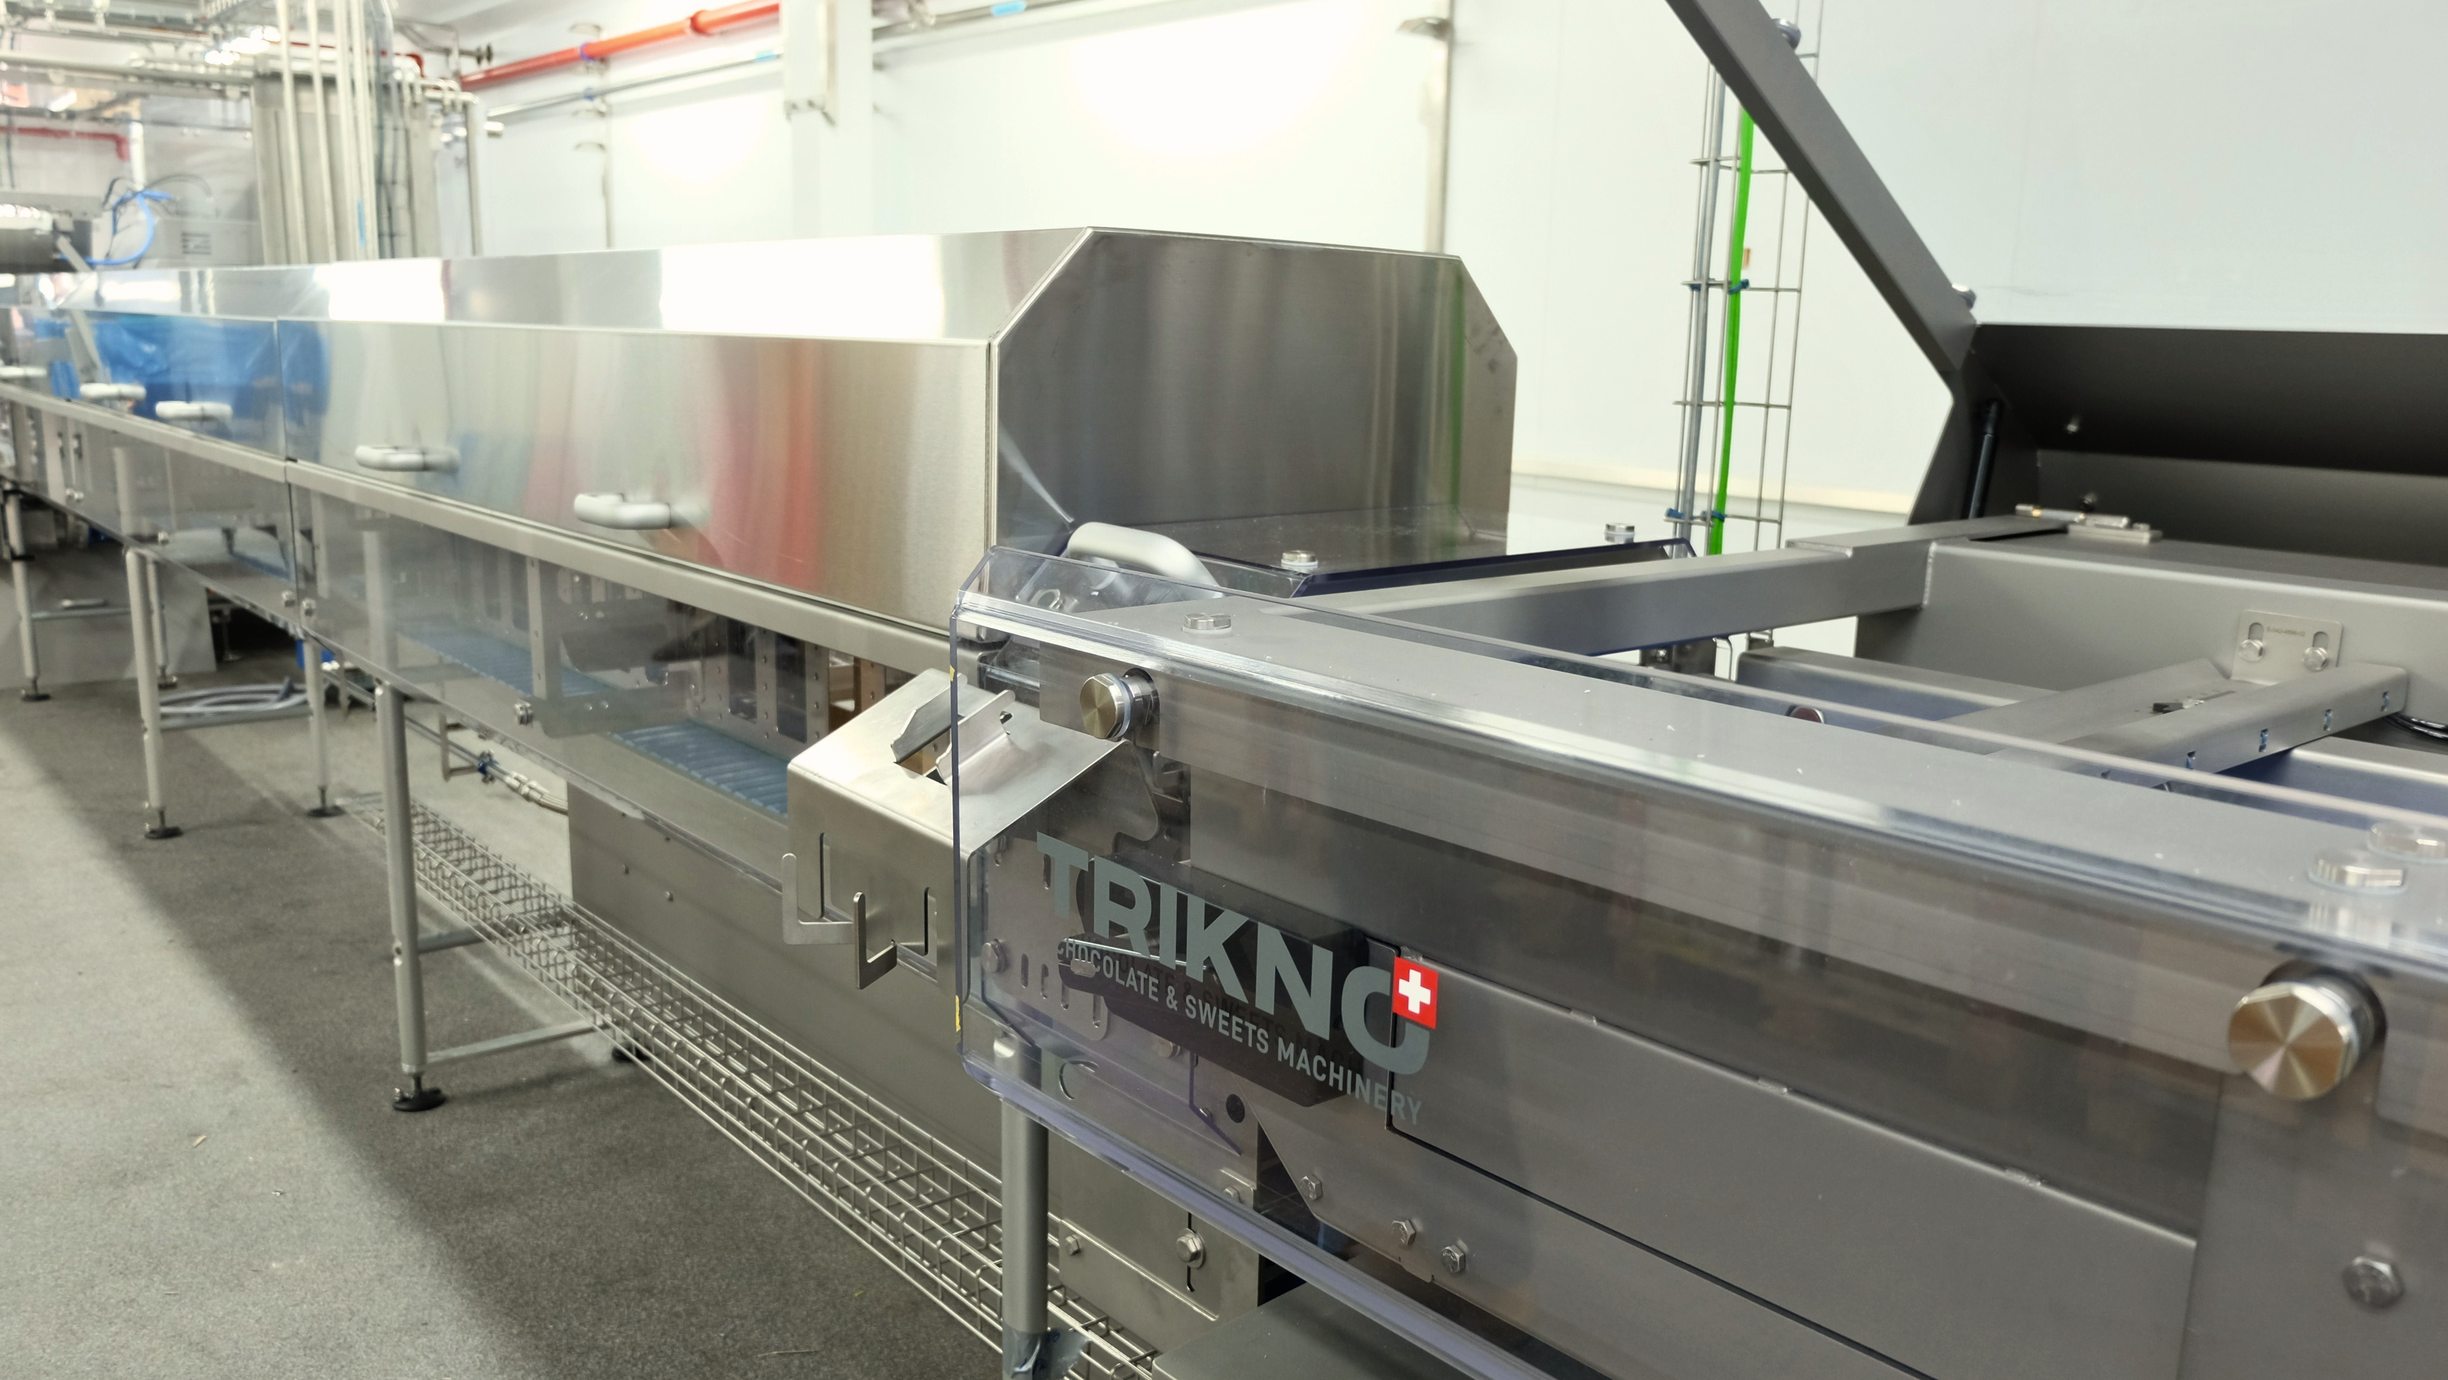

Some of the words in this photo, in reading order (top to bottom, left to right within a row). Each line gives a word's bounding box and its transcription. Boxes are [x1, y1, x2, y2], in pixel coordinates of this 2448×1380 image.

[1036, 831, 1430, 1075] TRIKNO
[1165, 985, 1178, 1012] &
[1184, 994, 1270, 1054] SWEETS
[1277, 1041, 1422, 1126] MACHINERY
